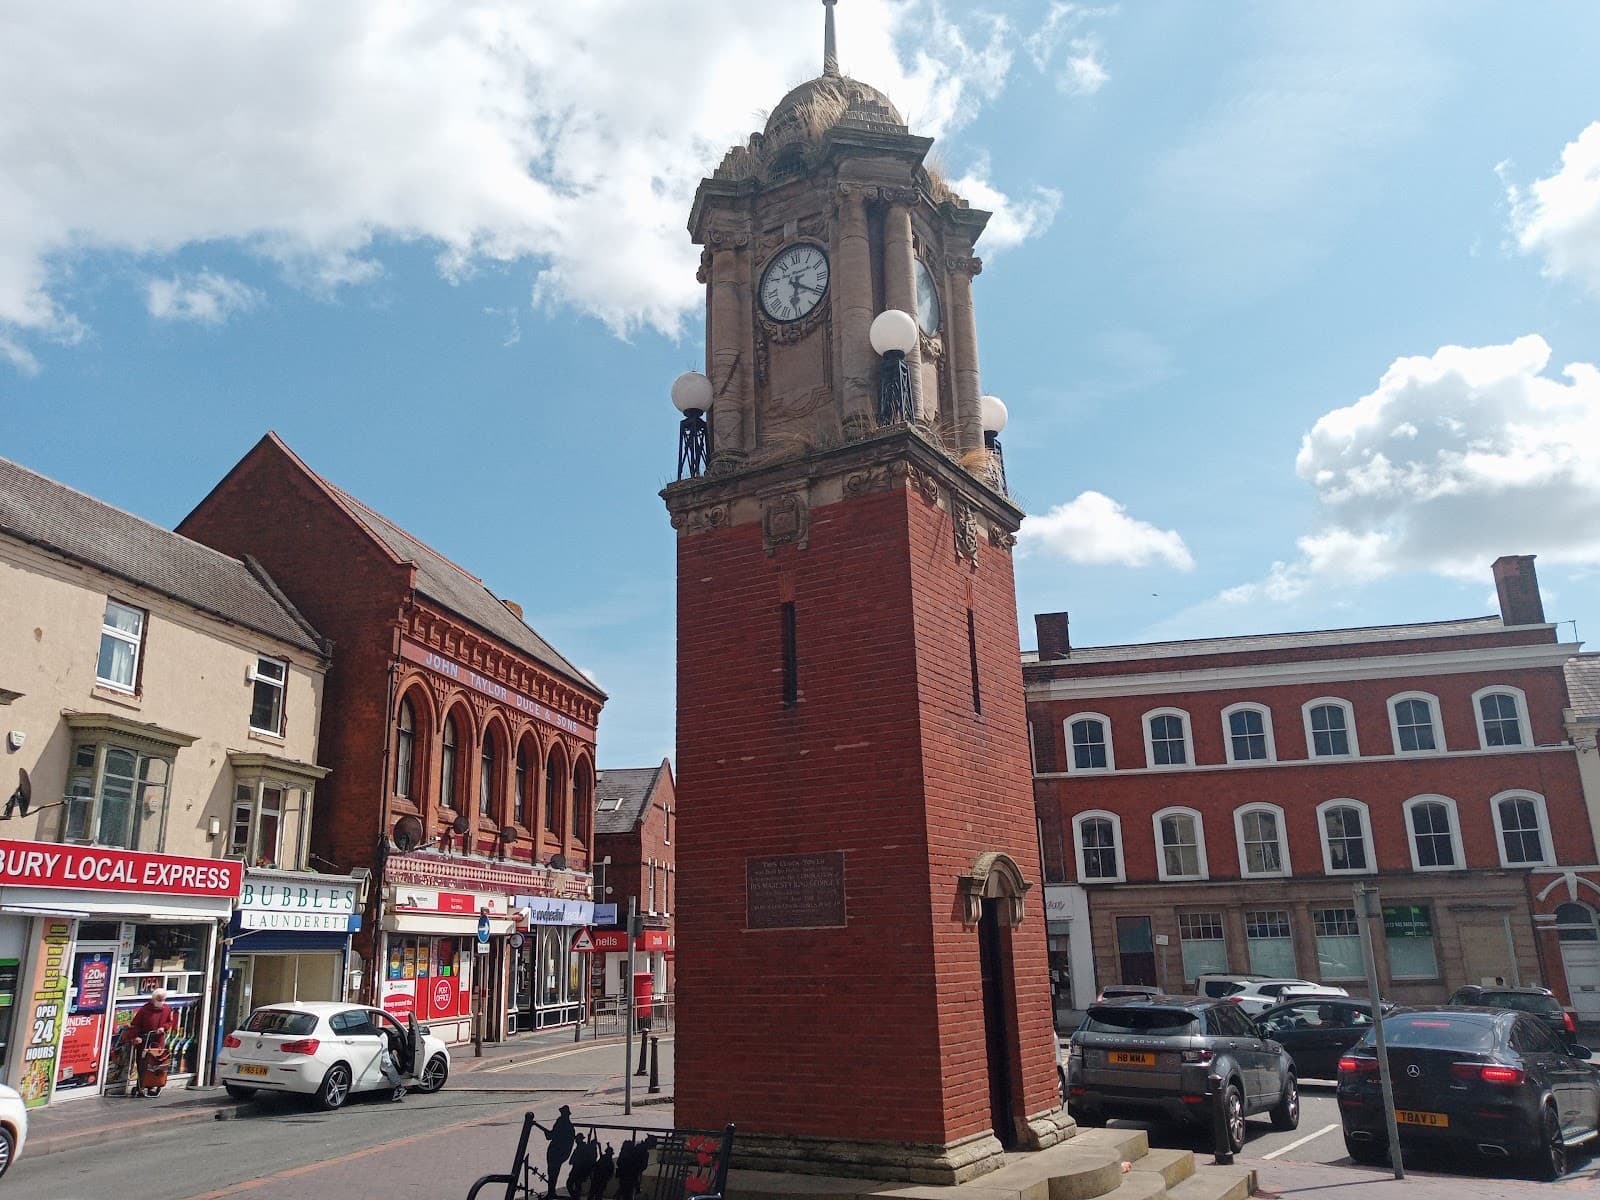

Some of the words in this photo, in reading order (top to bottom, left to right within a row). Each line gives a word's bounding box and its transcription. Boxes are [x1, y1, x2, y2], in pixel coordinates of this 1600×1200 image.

[426, 653, 458, 677] JOHN
[470, 671, 507, 700] TAYLOR
[516, 694, 541, 716] DUCE
[544, 709, 551, 721] &
[557, 714, 577, 733] SONS
[64, 855, 138, 884] LOCAL
[143, 863, 231, 890] EXPRESS
[242, 884, 353, 910] BUBBLES
[249, 914, 348, 929] LAUNDERETT
[36, 1004, 58, 1018] OPEN
[31, 1019, 55, 1044] 24
[26, 1045, 55, 1061] HOURS
